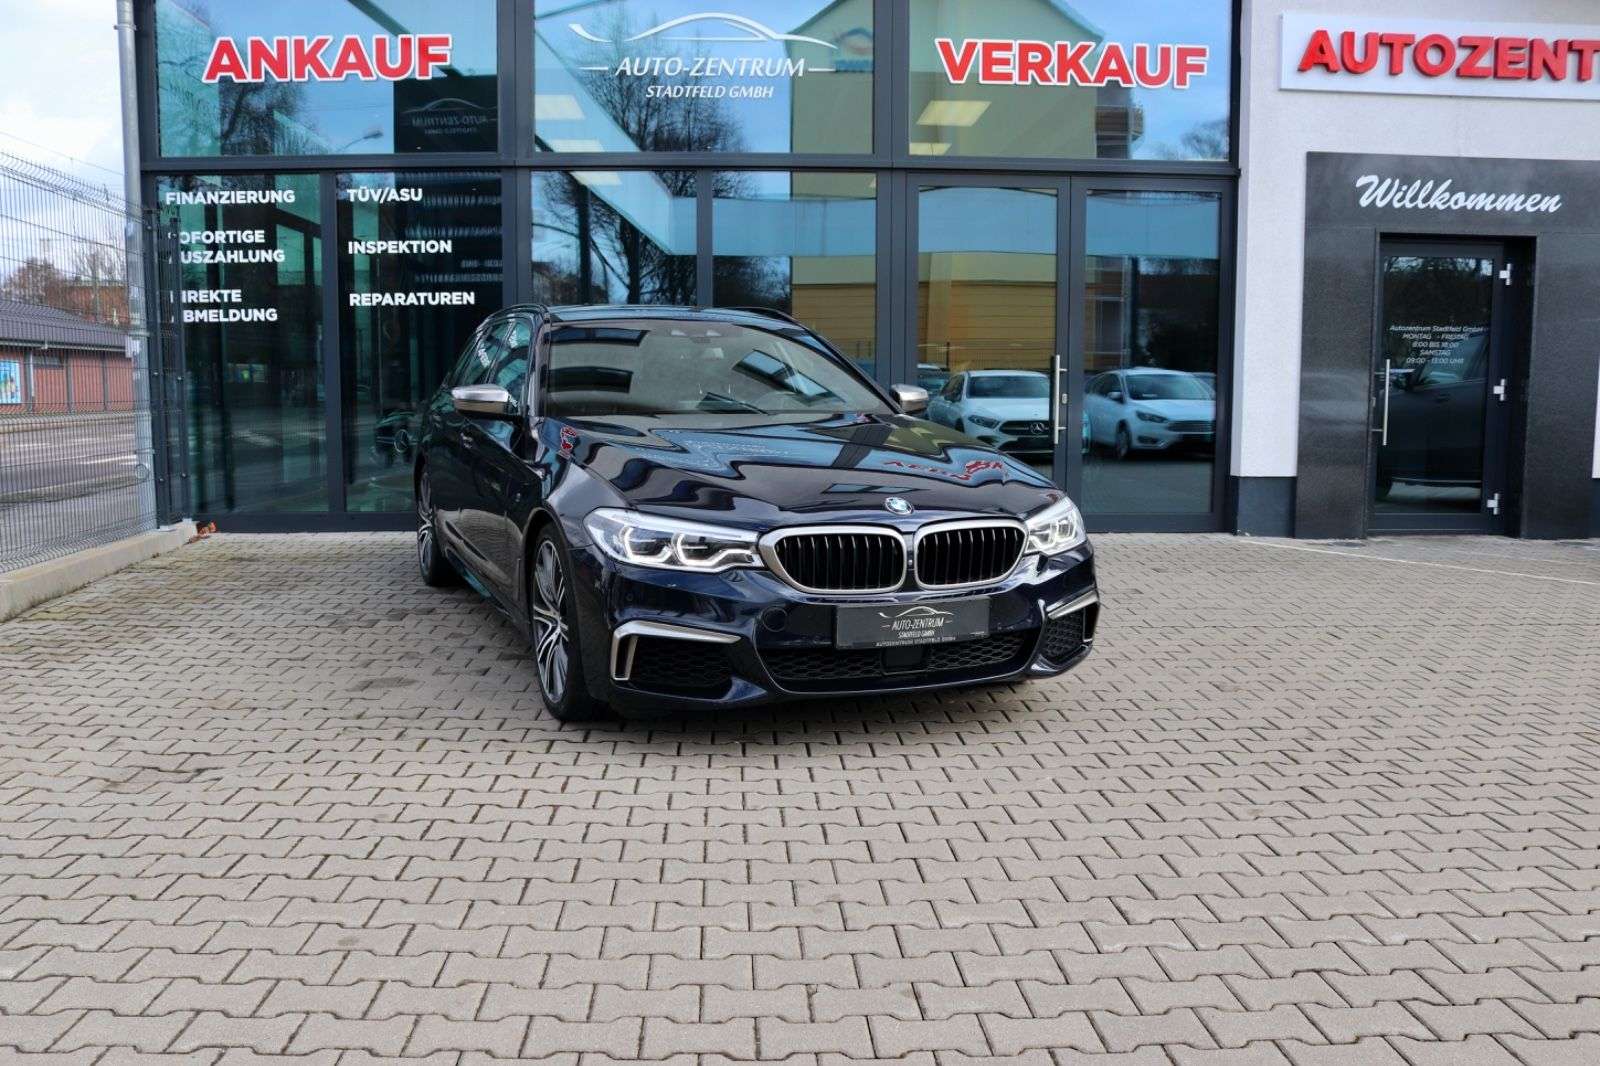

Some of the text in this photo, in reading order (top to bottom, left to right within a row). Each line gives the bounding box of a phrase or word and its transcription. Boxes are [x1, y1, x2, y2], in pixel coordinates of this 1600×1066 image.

[203, 34, 451, 82] ANKAUF
[1298, 29, 1600, 81] AUTOZENT
[615, 57, 805, 77] AUTO-ZENTRUM
[935, 38, 1208, 89] VERKAUF
[646, 85, 774, 98] STADTFELD GMBH
[165, 190, 296, 205] FINANZIERUNG
[347, 187, 423, 202] TÜV/ASU
[1355, 174, 1562, 213] Willkommen
[348, 240, 452, 254] INSPEKTION
[169, 249, 285, 264] USZAHLUNG
[170, 289, 242, 303] IREKTE
[349, 292, 475, 307] REPARATUREN
[171, 308, 278, 323] BMELDUNG
[892, 617, 944, 631] AUTO-ZENTRUM
